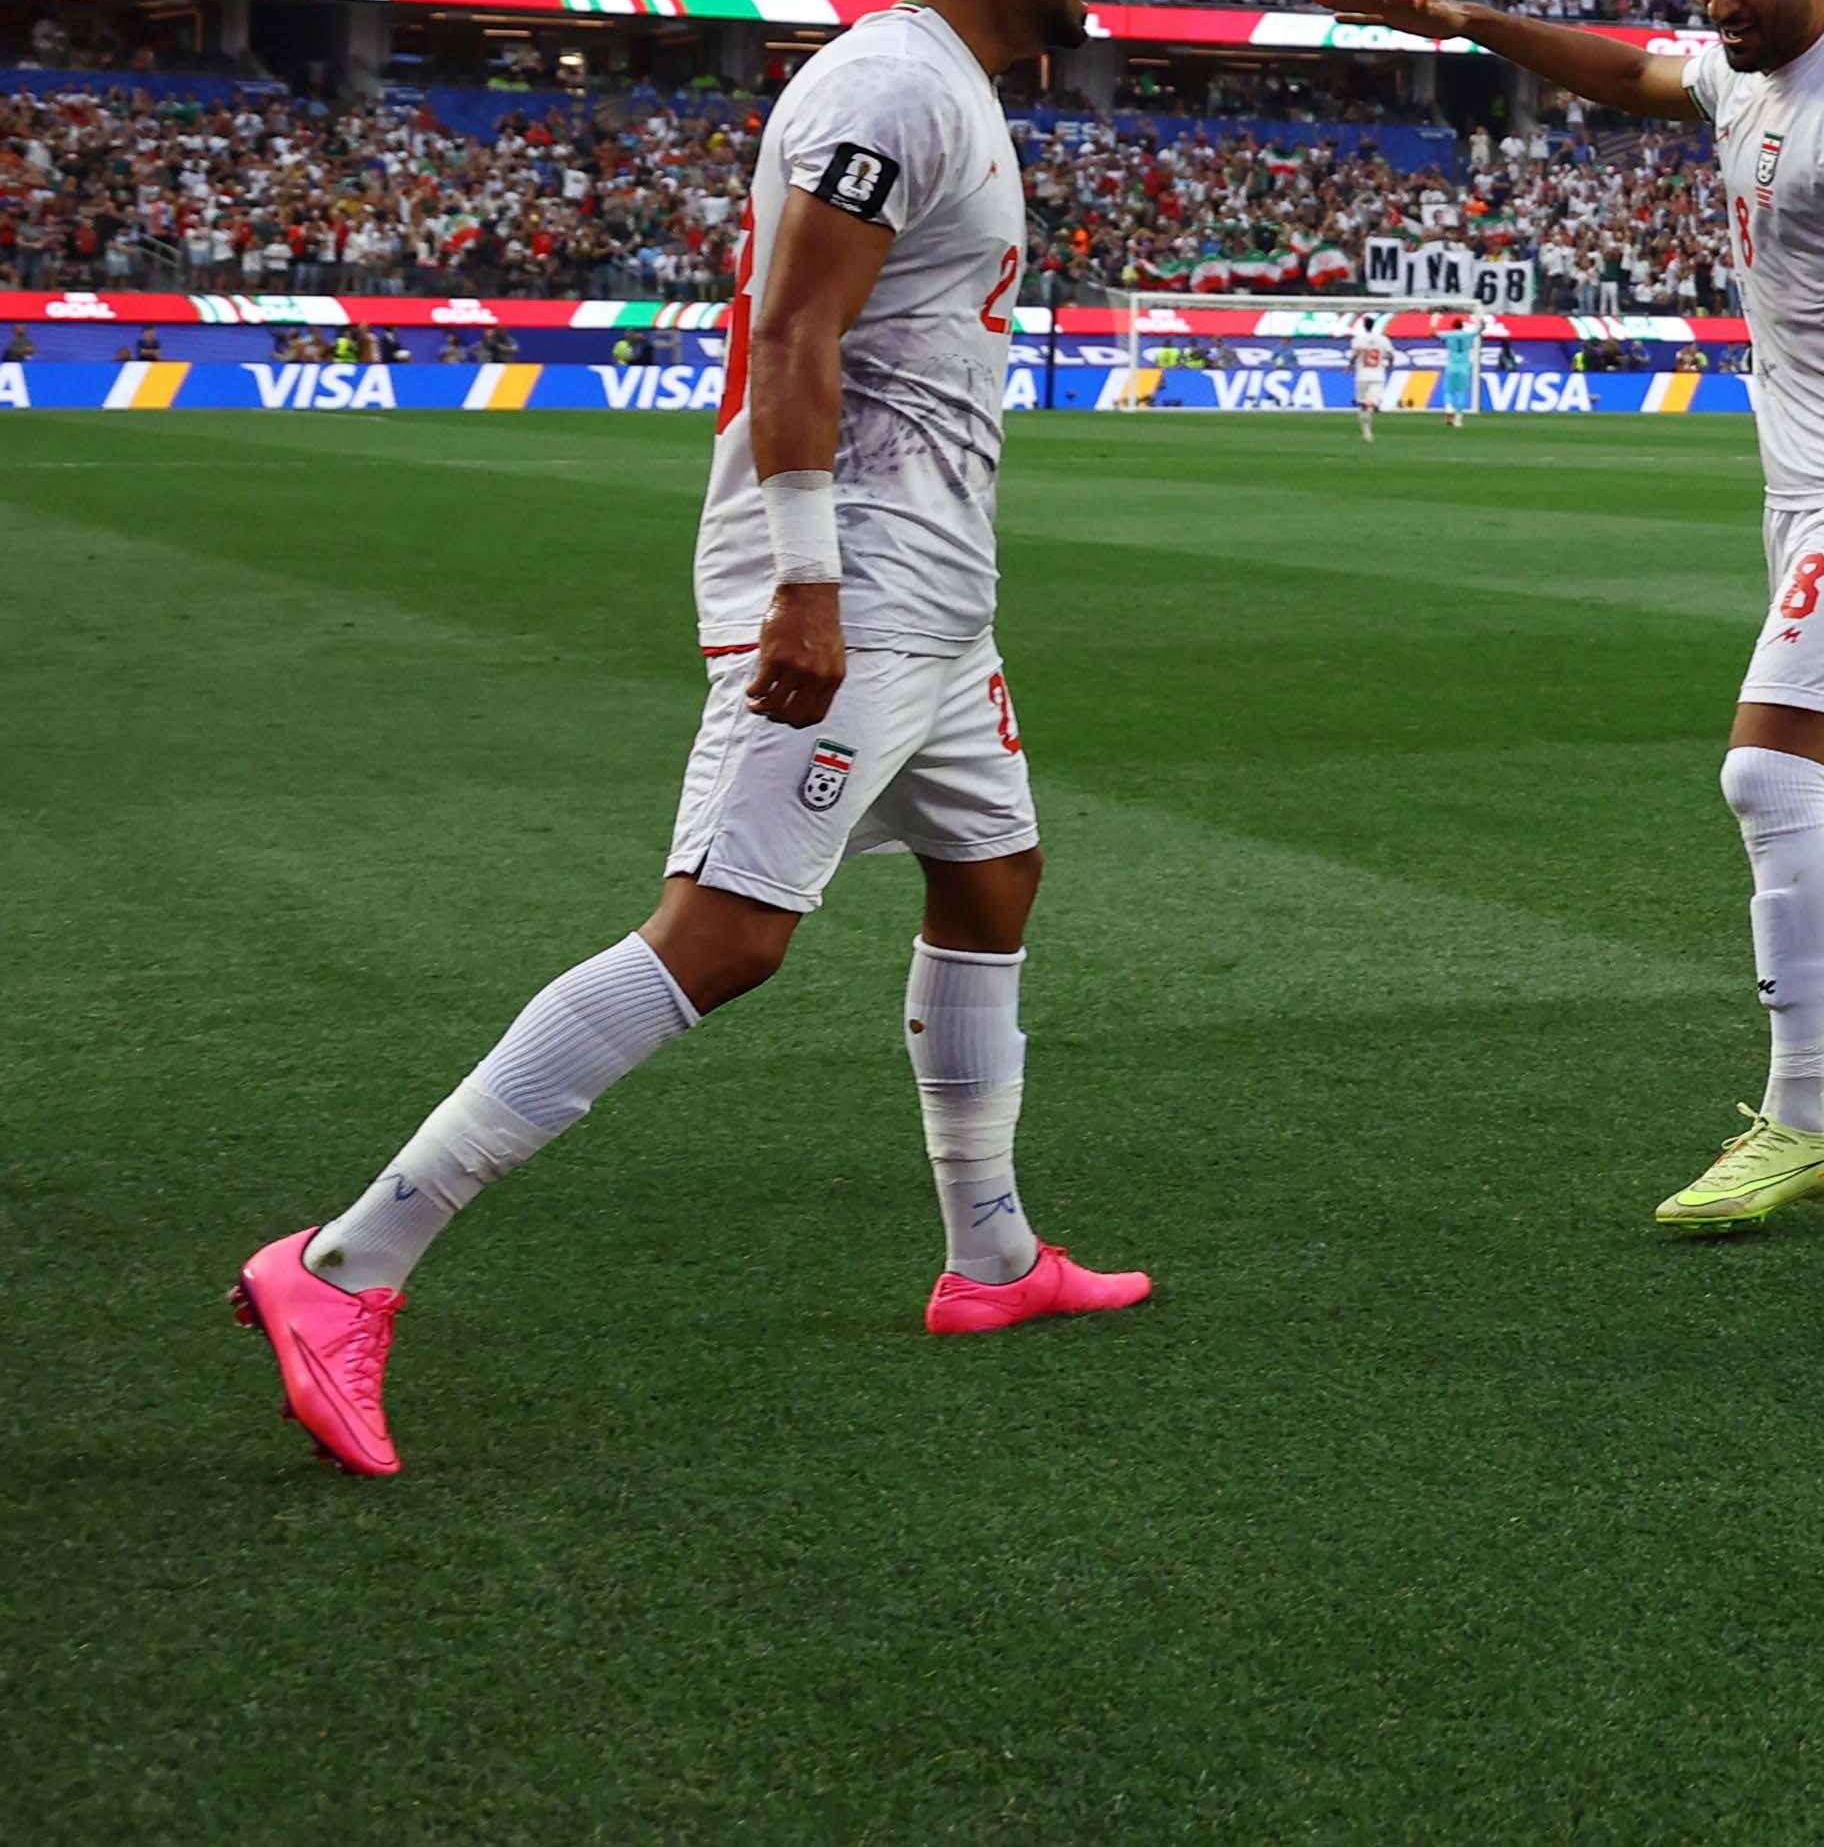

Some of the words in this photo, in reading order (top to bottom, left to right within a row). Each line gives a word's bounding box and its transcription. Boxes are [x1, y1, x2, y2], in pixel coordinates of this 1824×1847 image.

[1735, 195, 1754, 267] 8
[1479, 267, 1527, 305] 68
[46, 301, 117, 319] GOAL
[432, 307, 500, 324] GOAL
[240, 363, 398, 409] VISA
[590, 366, 722, 411] VISA
[1206, 369, 1338, 411] VISA
[1476, 373, 1595, 412] VISA
